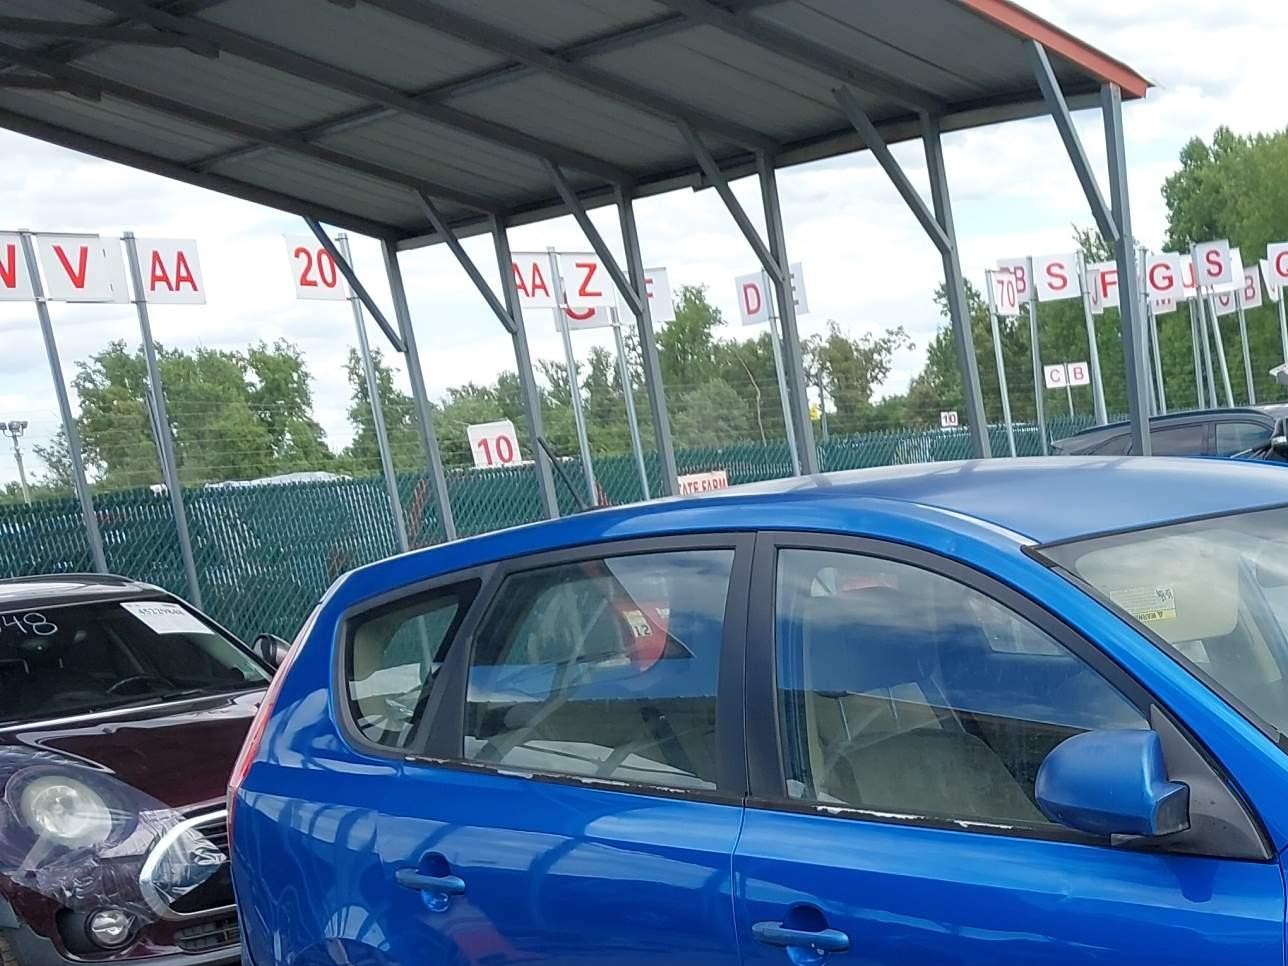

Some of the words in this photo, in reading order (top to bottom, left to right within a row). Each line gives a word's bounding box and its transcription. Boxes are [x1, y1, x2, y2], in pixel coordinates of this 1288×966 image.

[52, 245, 88, 289] V
[150, 250, 199, 291] AA
[294, 247, 337, 288] 20
[1046, 262, 1068, 290] S
[1149, 263, 1174, 291] G
[1206, 250, 1223, 277] S
[575, 263, 602, 297] Z
[997, 280, 1016, 307] 70
[1100, 270, 1118, 297] F
[743, 283, 761, 315] D
[1050, 368, 1060, 382] C
[1073, 367, 1084, 380] B
[478, 435, 513, 465] 10
[0, 612, 58, 636] 48
